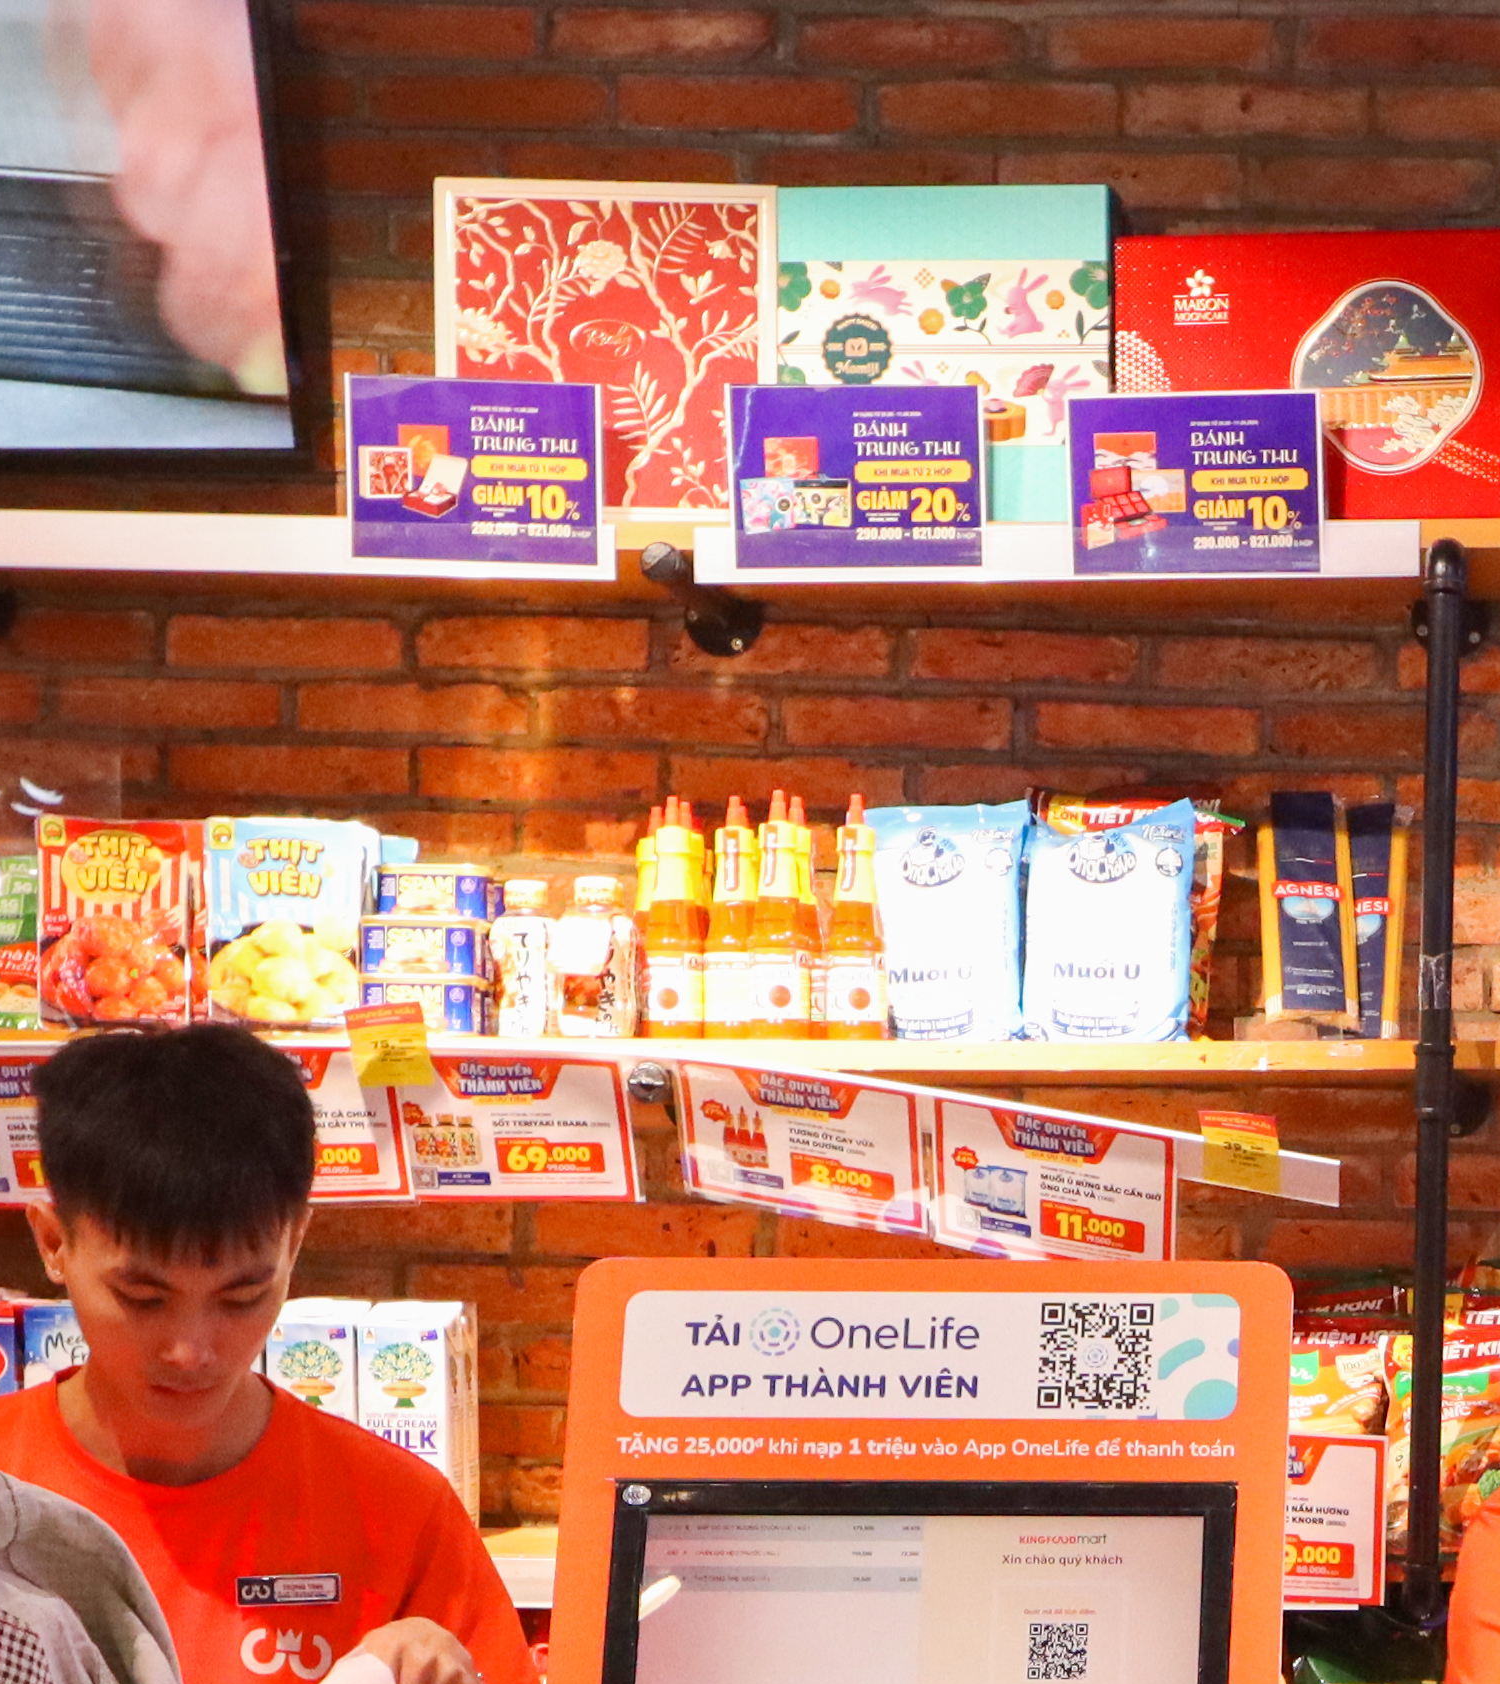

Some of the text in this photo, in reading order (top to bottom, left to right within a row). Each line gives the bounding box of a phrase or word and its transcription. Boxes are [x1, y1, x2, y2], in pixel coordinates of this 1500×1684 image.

[1174, 298, 1229, 311] MAISON
[470, 415, 525, 433] BÁNH
[853, 421, 907, 438] BÁNH
[472, 436, 578, 454] TRUNG THU
[854, 441, 960, 456] TRUNG THU
[1190, 430, 1244, 447] BÁNH
[1192, 448, 1298, 466] TRUNG THU
[856, 487, 908, 511] GIẢM
[1193, 495, 1245, 519] GIẢM
[246, 837, 325, 864] THỊT
[77, 860, 150, 893] VIÊN
[246, 863, 322, 898] VIÊN
[398, 874, 454, 895] SPAM
[1274, 883, 1341, 899] AGNESI
[386, 926, 445, 947] SPAM
[1013, 1130, 1062, 1150] THÀNH
[506, 1145, 591, 1172] 69.000
[810, 1163, 874, 1189] 8.000
[1055, 1212, 1126, 1241] 11.000
[684, 1314, 980, 1351] TẢI OneLife
[681, 1366, 980, 1399] APP THÀNH VIÊN
[365, 1418, 438, 1429] FULL CREAM
[616, 1435, 1235, 1461] TẶNG khi nạp 1 triệu vào App OneLife để thanh toán
[1291, 1515, 1325, 1526] KNORR
[1019, 1533, 1107, 1544] KINGFOODmart
[1002, 1554, 1123, 1565] Xin chào khách
